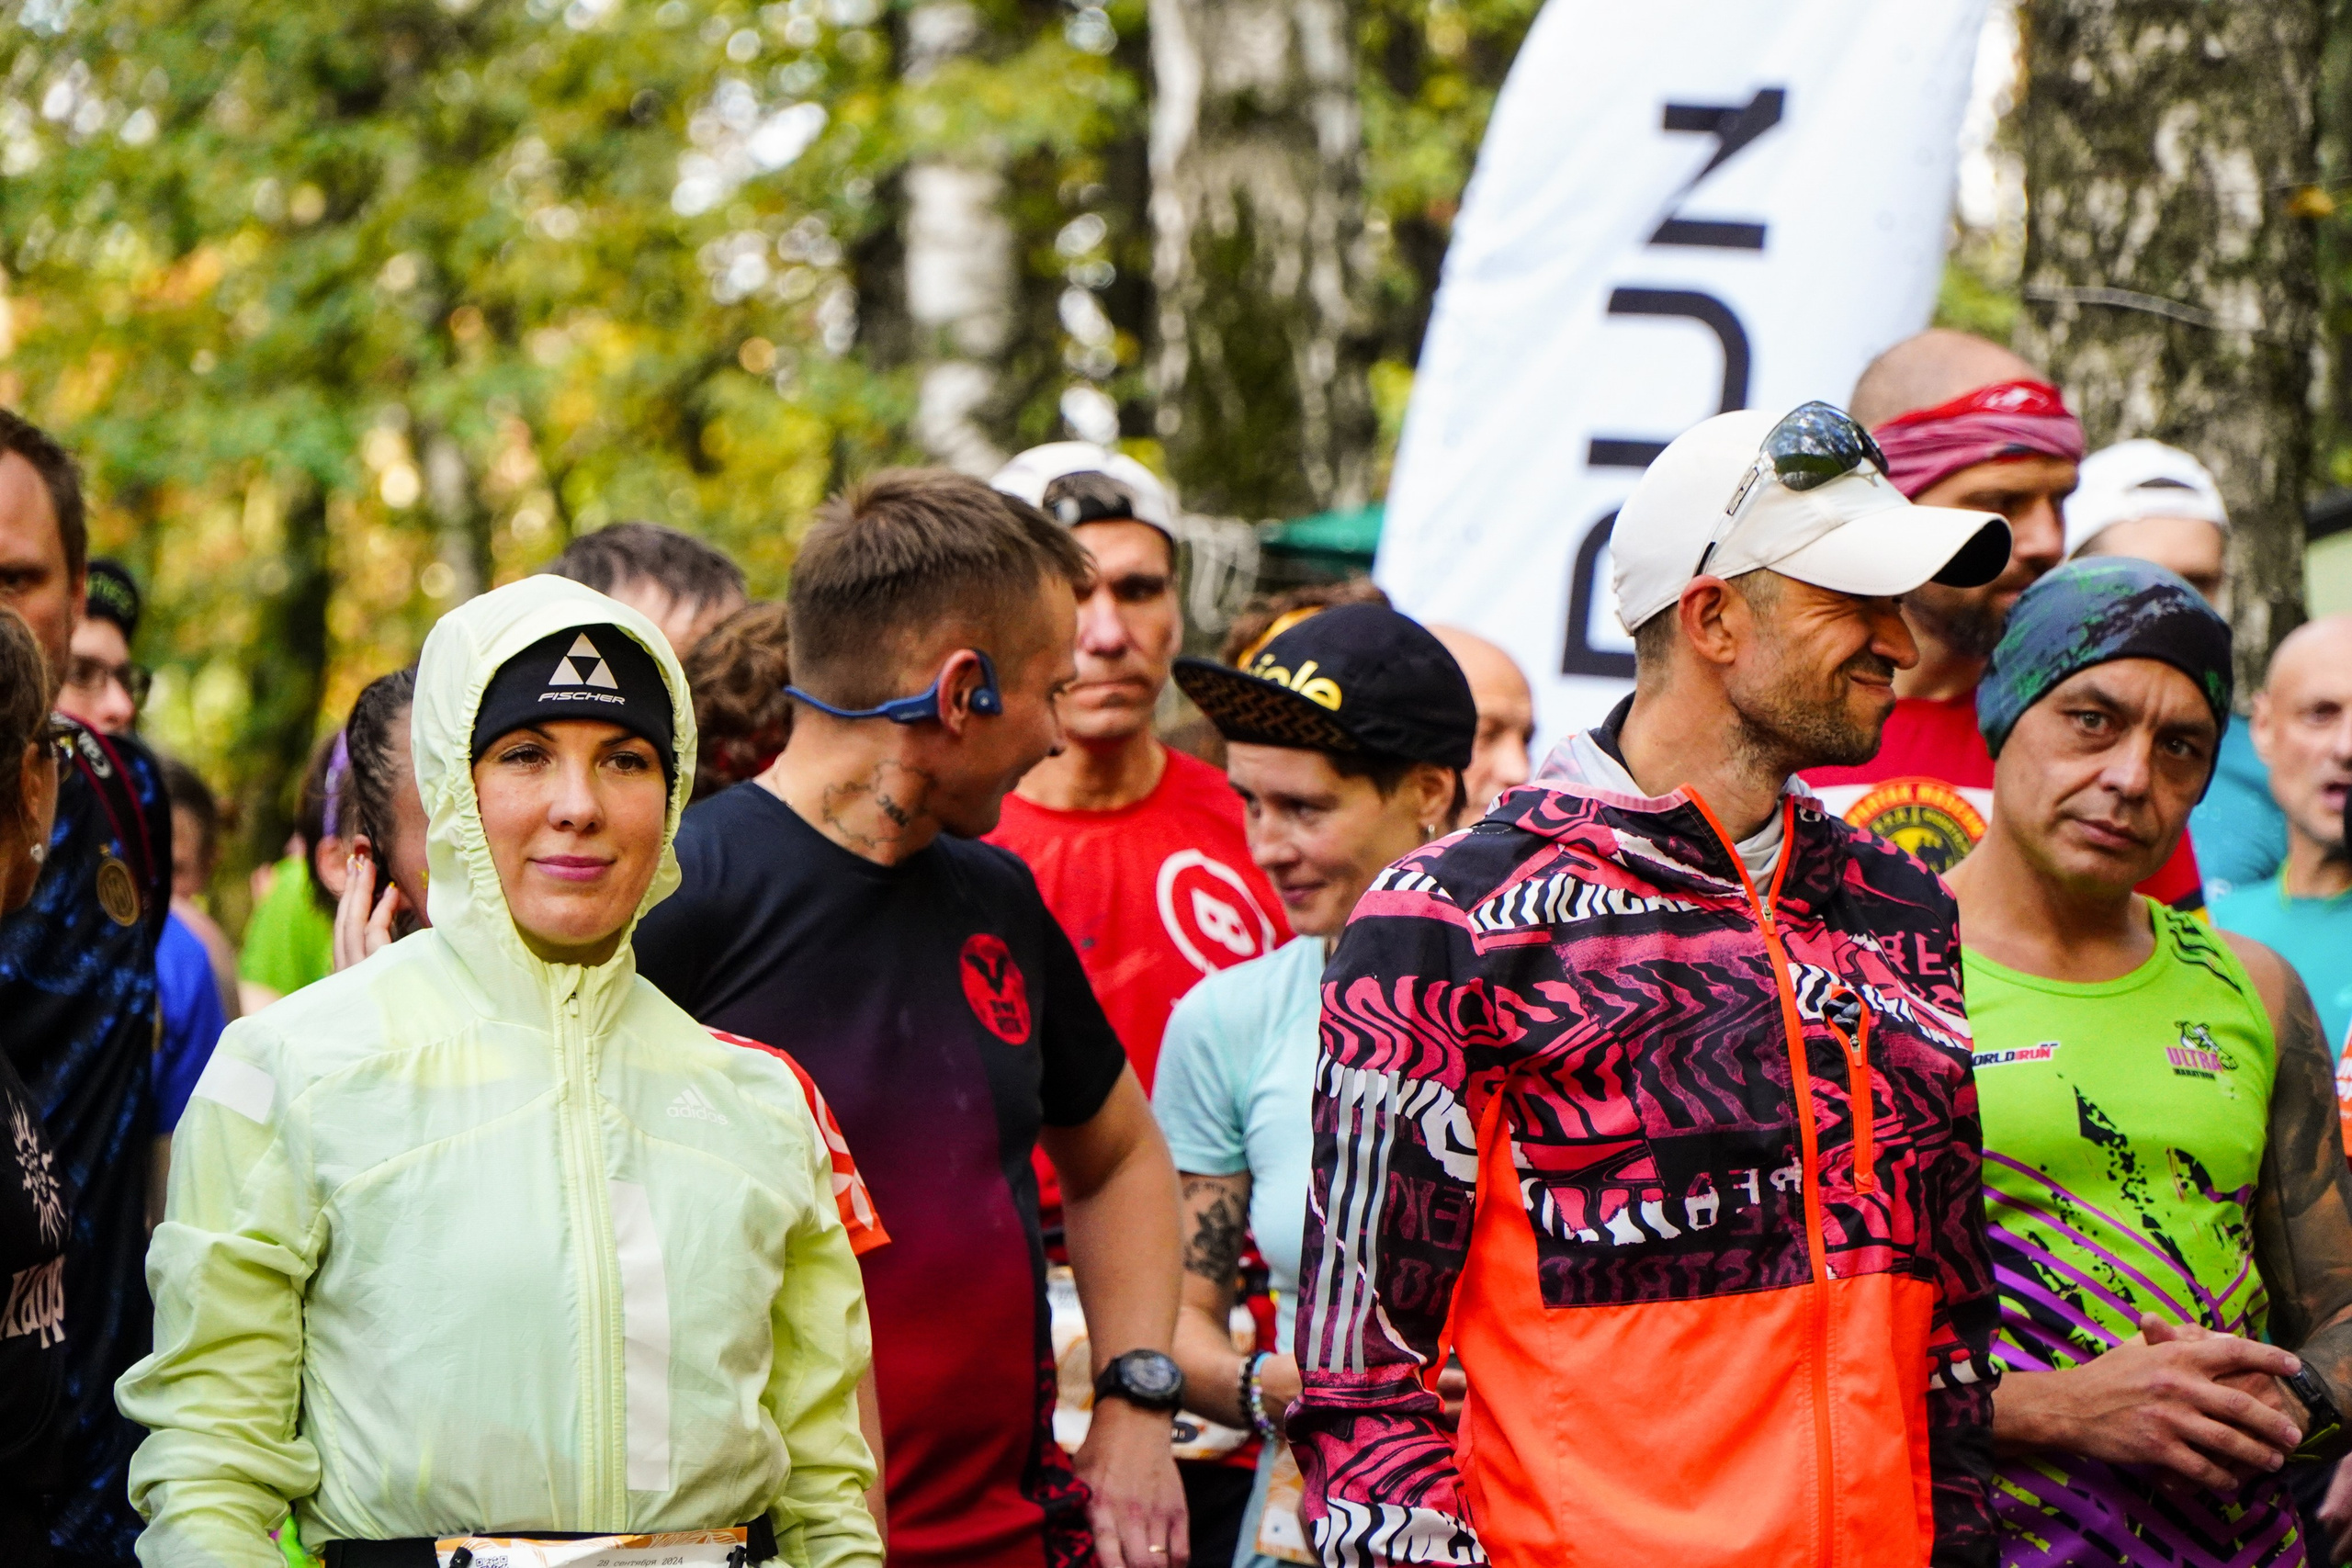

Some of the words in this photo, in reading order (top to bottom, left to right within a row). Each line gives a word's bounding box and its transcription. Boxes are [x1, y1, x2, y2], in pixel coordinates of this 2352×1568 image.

[537, 691, 626, 705] FISCHER
[1973, 1046, 2051, 1066] ORLDRUN
[2165, 1046, 2223, 1073] ULTRA
[666, 1103, 729, 1125] adidas
[614, 1559, 658, 1568] сентября
[662, 1556, 684, 1566] 2024
